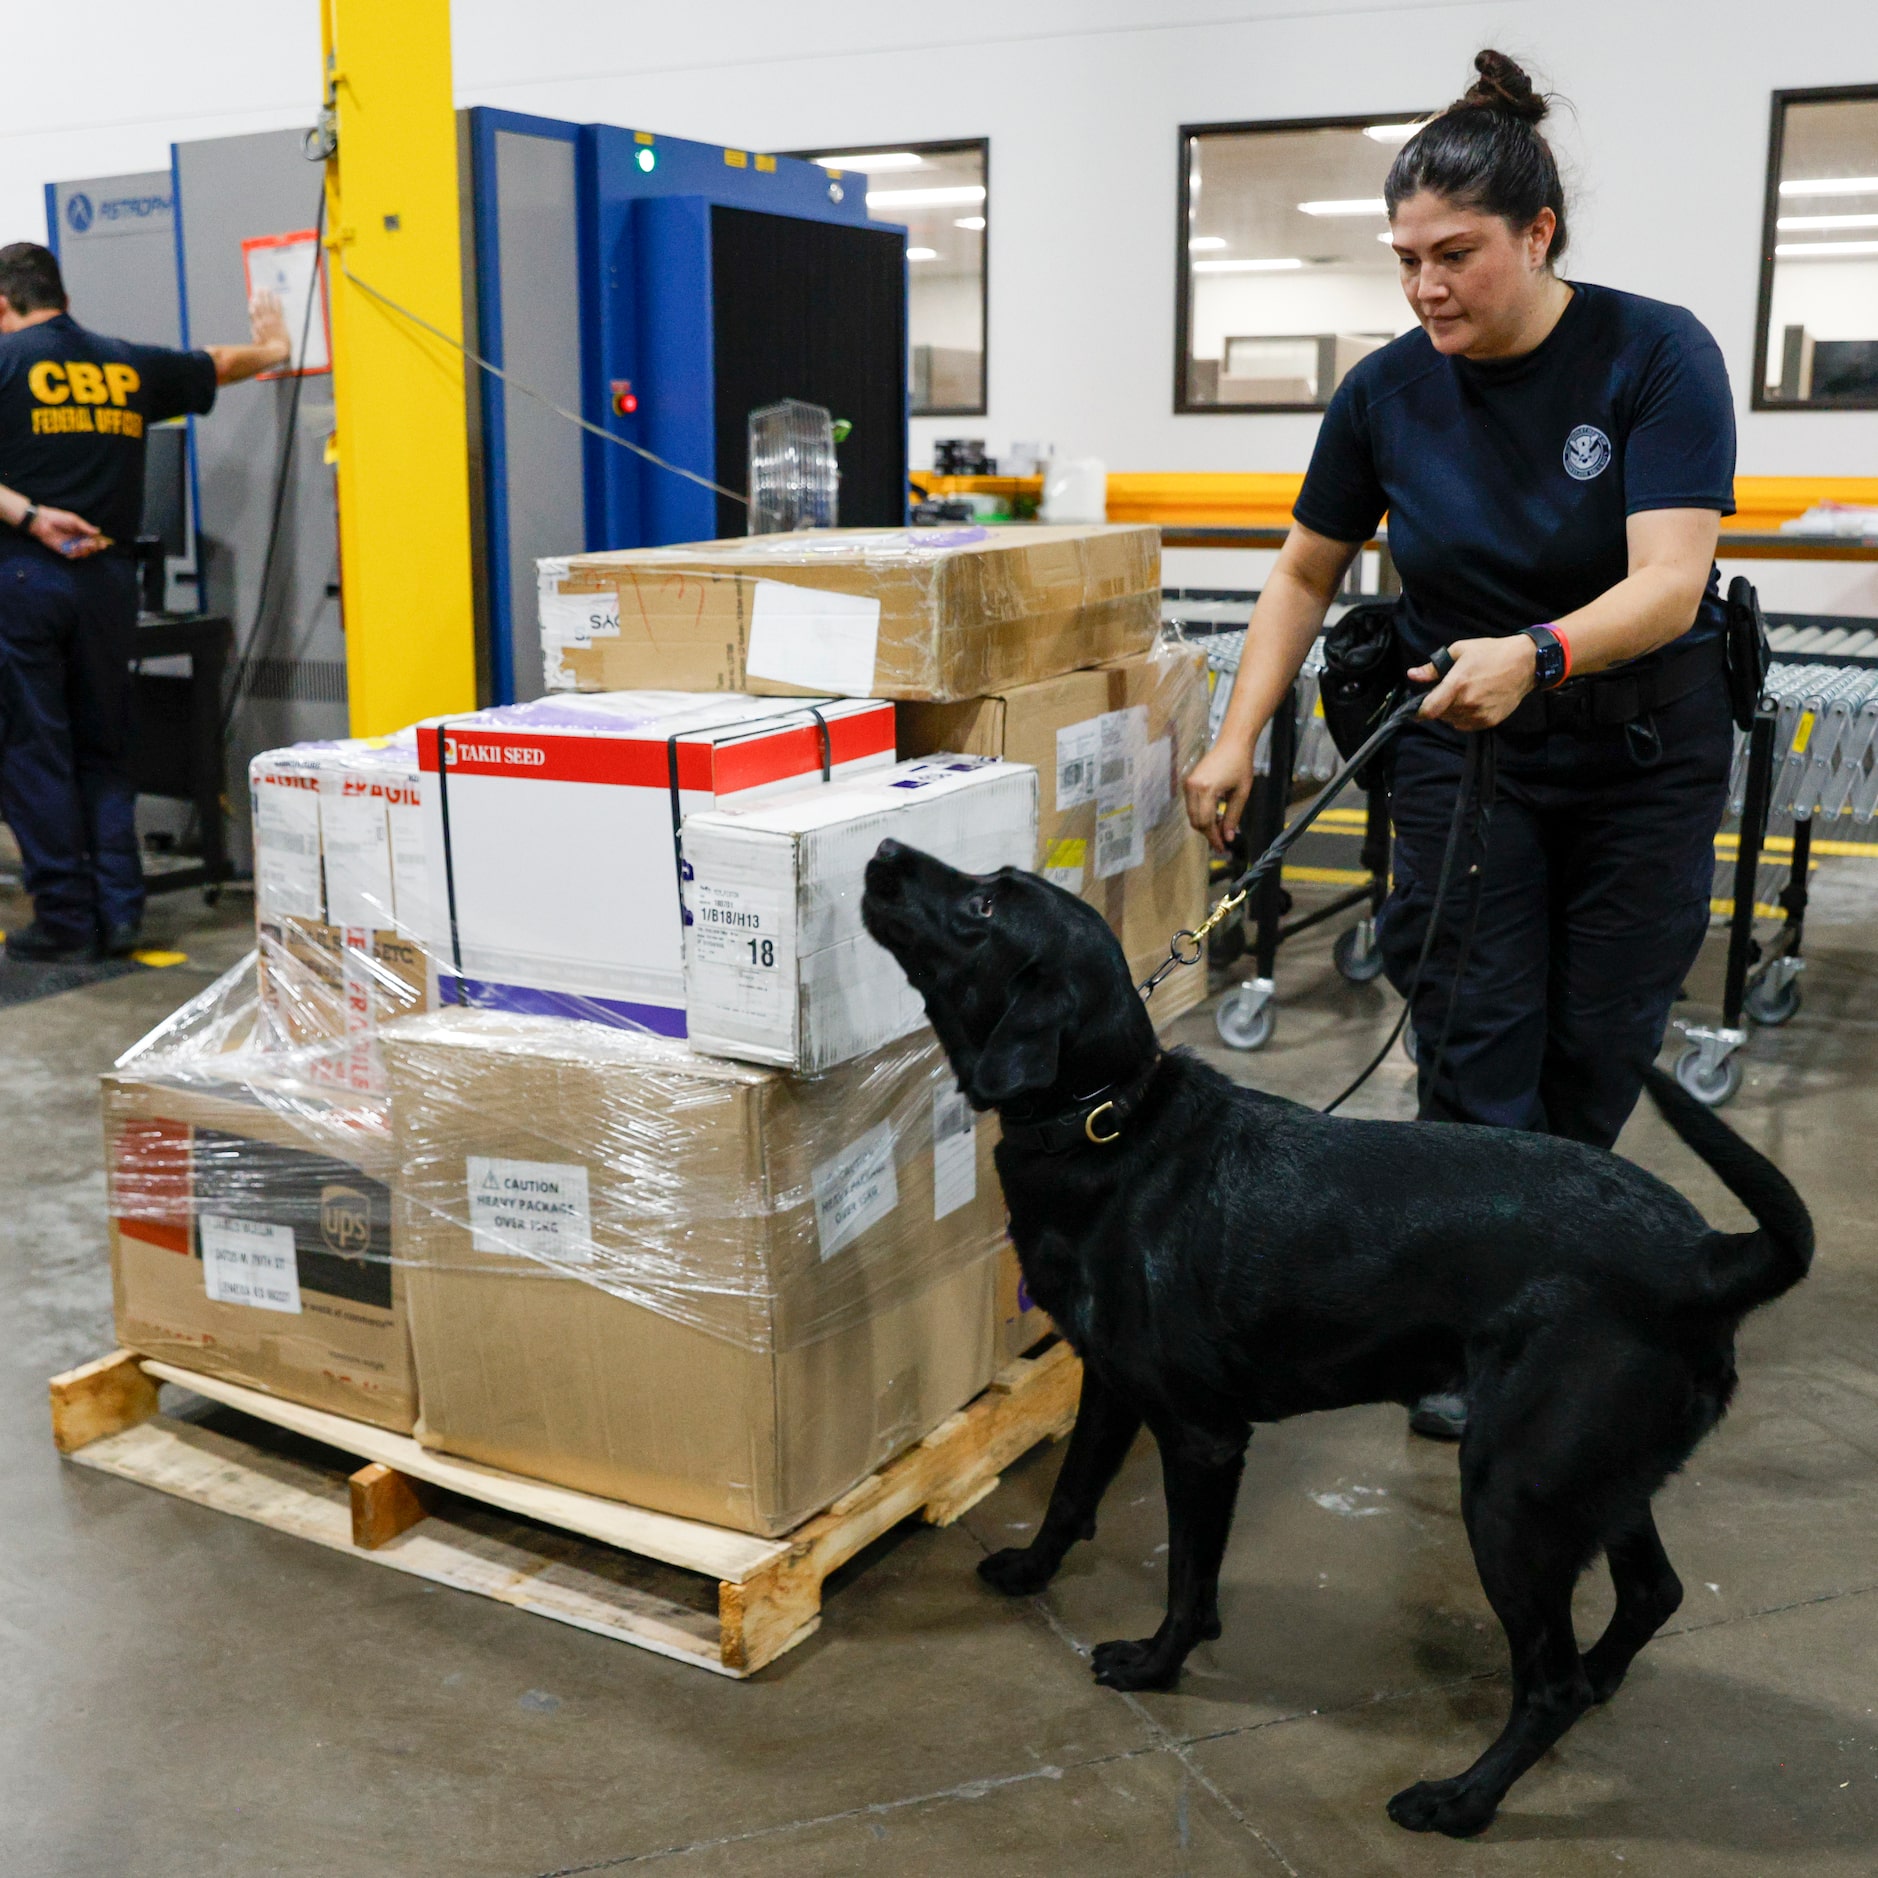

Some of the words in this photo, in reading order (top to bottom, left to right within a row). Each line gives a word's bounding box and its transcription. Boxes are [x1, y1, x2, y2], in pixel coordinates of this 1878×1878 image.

[28, 359, 141, 407] CBP
[459, 744, 501, 763] TAKII
[503, 747, 545, 765] SEED
[701, 907, 760, 929] 1/B18/H13
[747, 938, 775, 967] 18
[504, 1178, 560, 1194] CAUTION
[476, 1195, 515, 1208] HEAVY
[325, 1206, 367, 1248] ups
[494, 1216, 527, 1230] OVER
